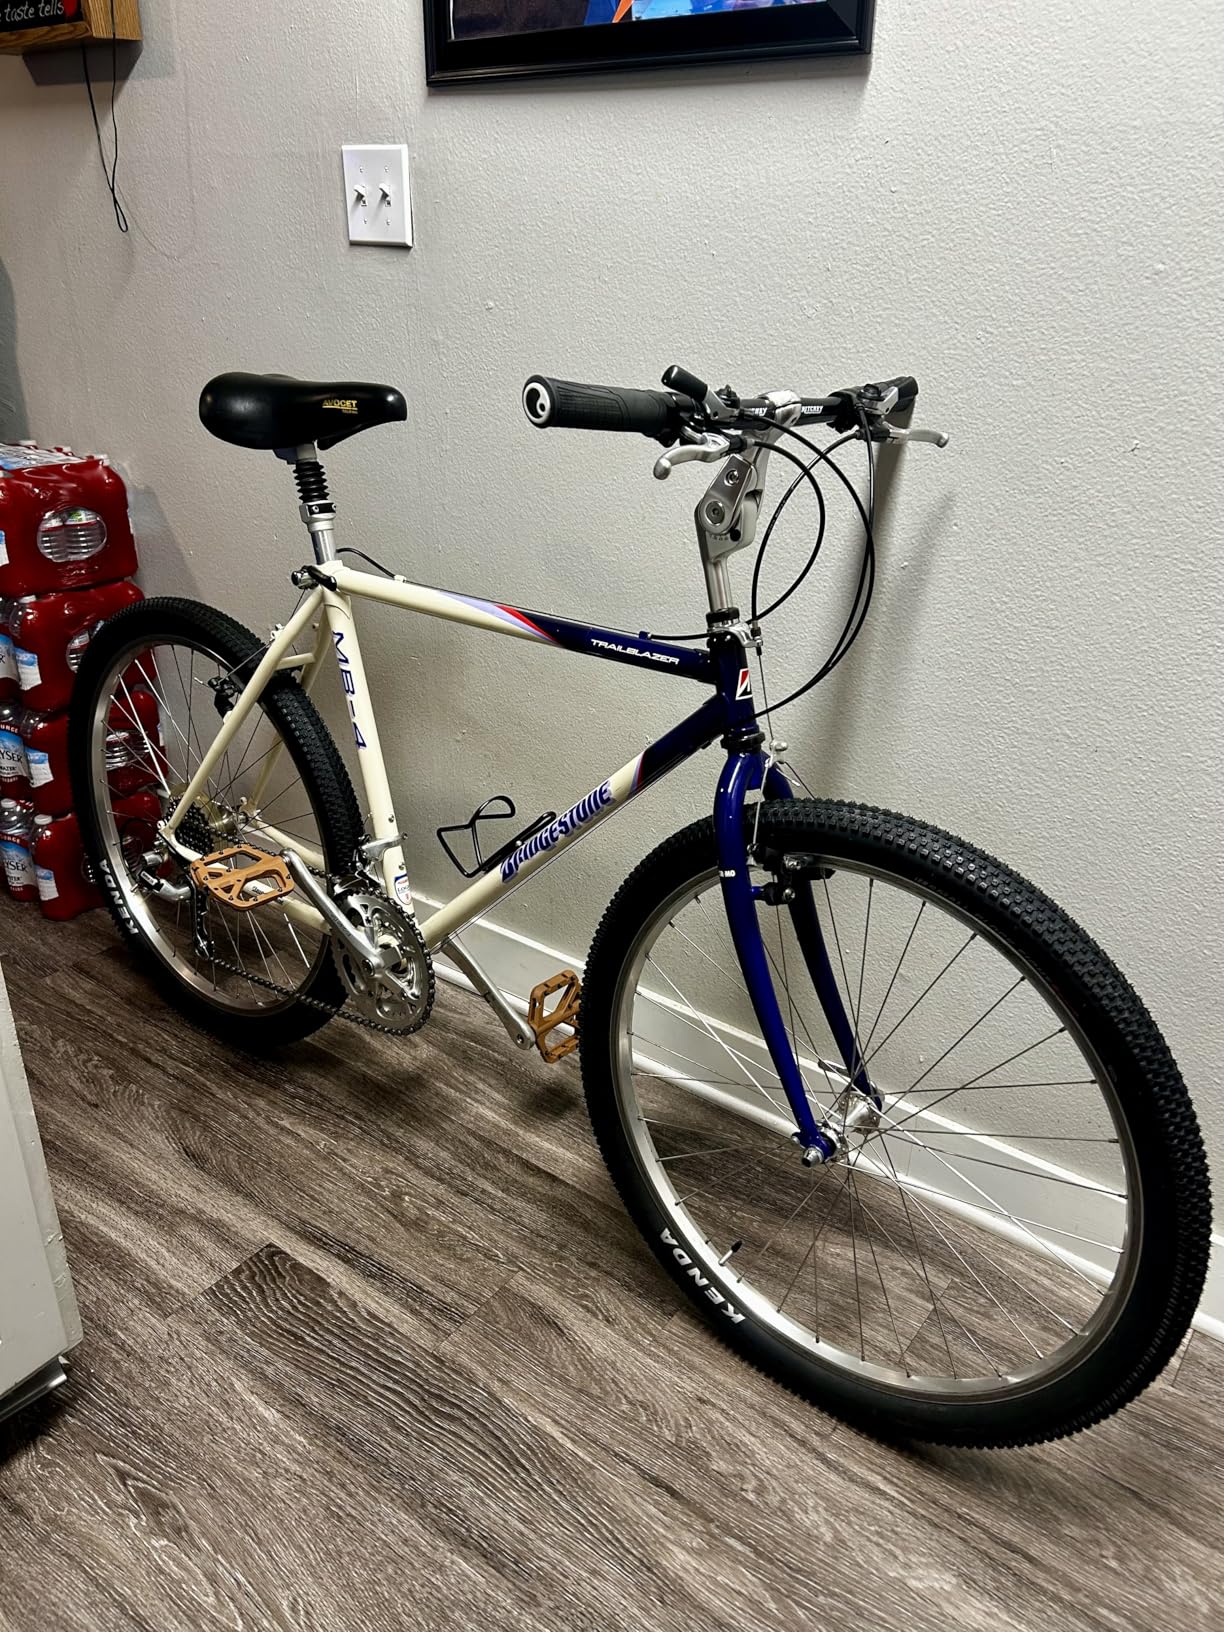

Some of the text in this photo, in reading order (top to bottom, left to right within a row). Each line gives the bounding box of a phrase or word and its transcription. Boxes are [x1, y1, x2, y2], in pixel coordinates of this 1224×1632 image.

[4, 1, 35, 22] taste
[38, 0, 64, 17] tells
[323, 400, 358, 408] AVOCET
[591, 638, 680, 665] TRAILBLAZER
[332, 630, 367, 750] MB-4
[0, 749, 23, 764] YSER
[500, 780, 613, 883] BRIDGESTONE
[99, 858, 139, 935] KENDA
[660, 1227, 746, 1324] KENDA
